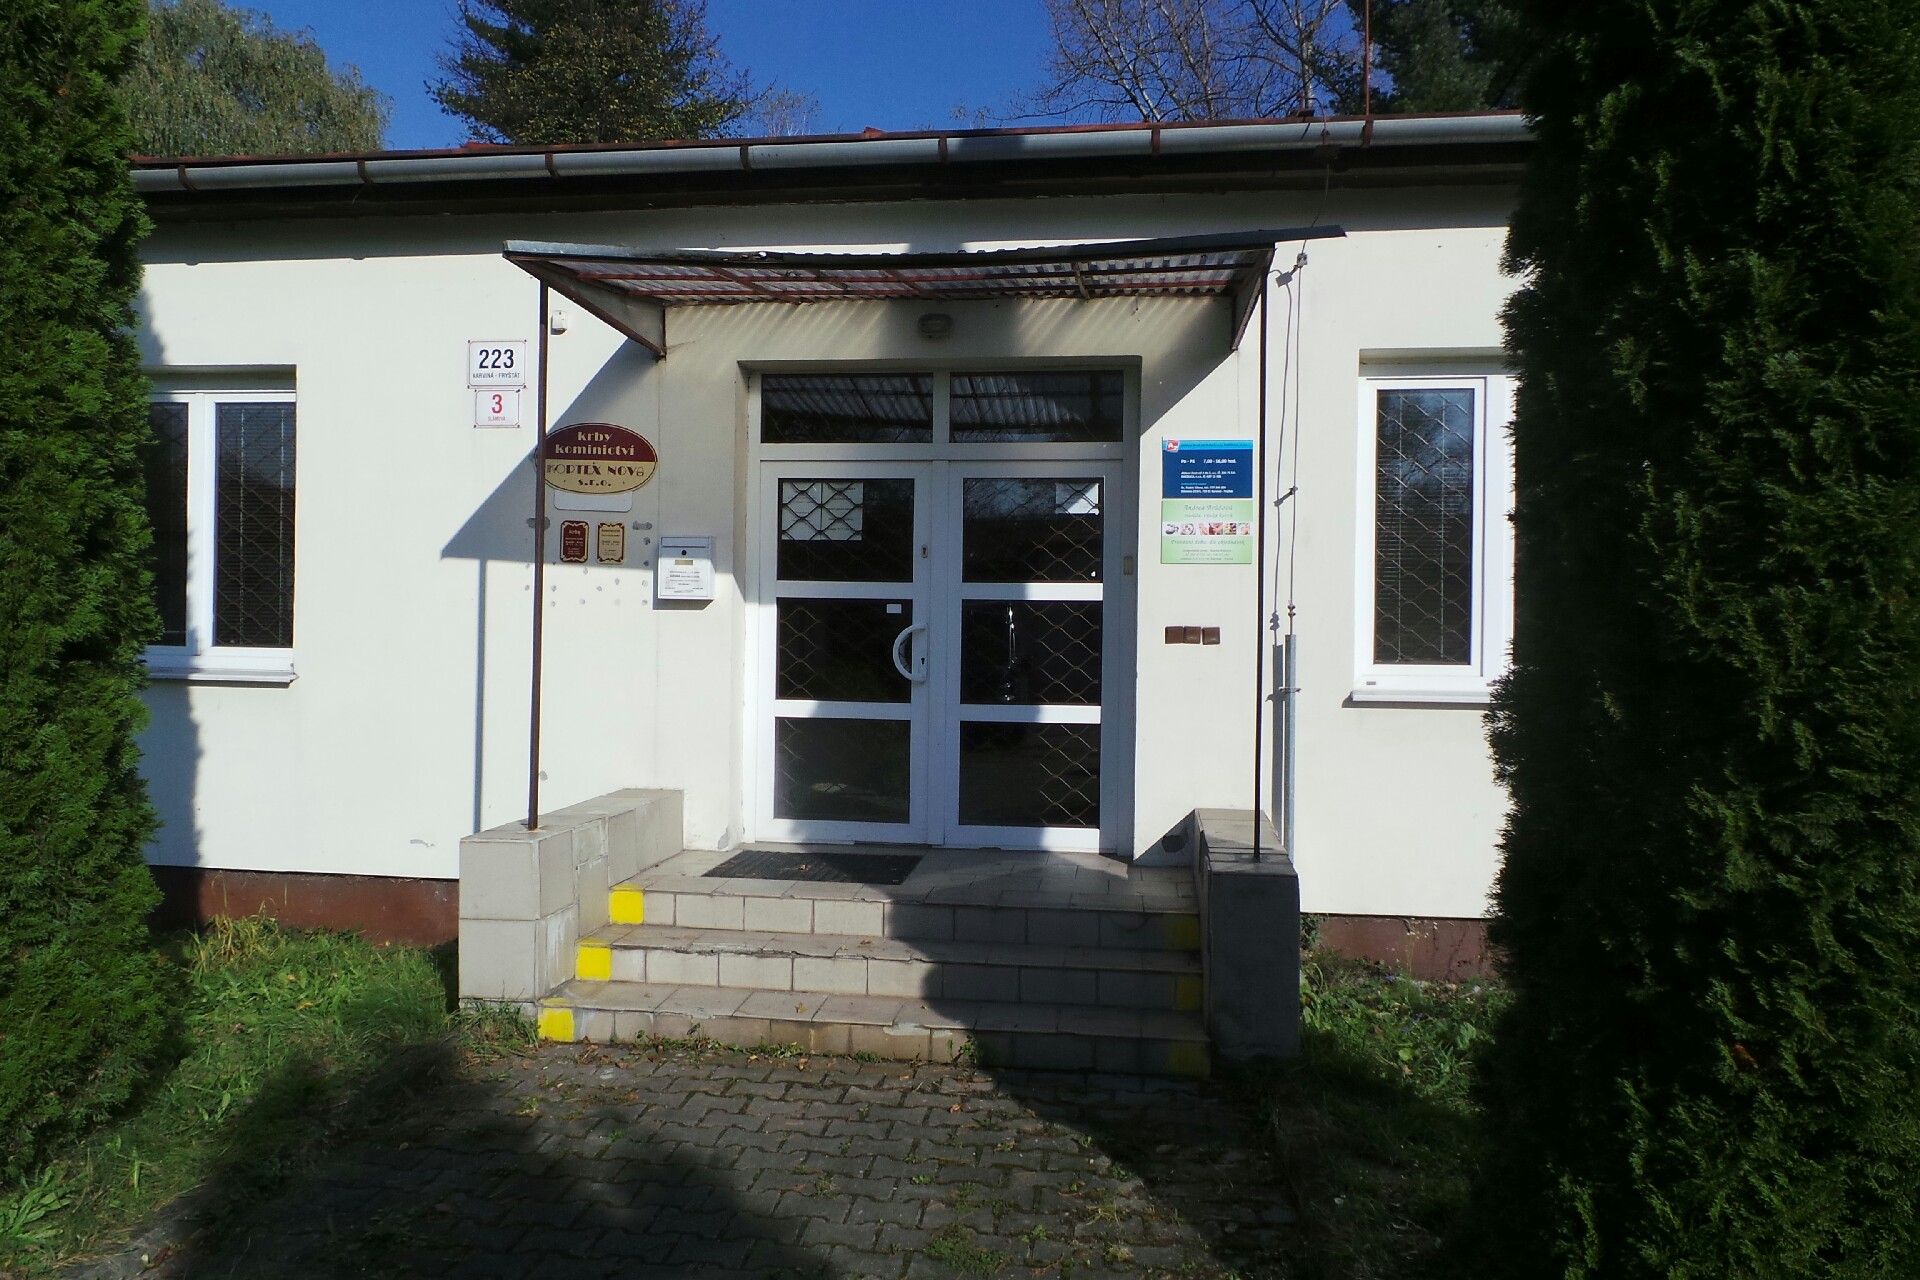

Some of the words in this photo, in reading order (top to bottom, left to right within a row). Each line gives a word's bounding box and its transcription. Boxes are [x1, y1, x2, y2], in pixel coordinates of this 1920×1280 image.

[478, 348, 514, 369] 223
[472, 371, 494, 379] KARVINÁ
[498, 371, 521, 379] FRYŠTÁT
[491, 393, 503, 414] 3
[577, 431, 613, 443] krby
[555, 443, 635, 456] kominictví
[546, 463, 602, 476] KOPTEX
[578, 479, 612, 487] s.r.o.
